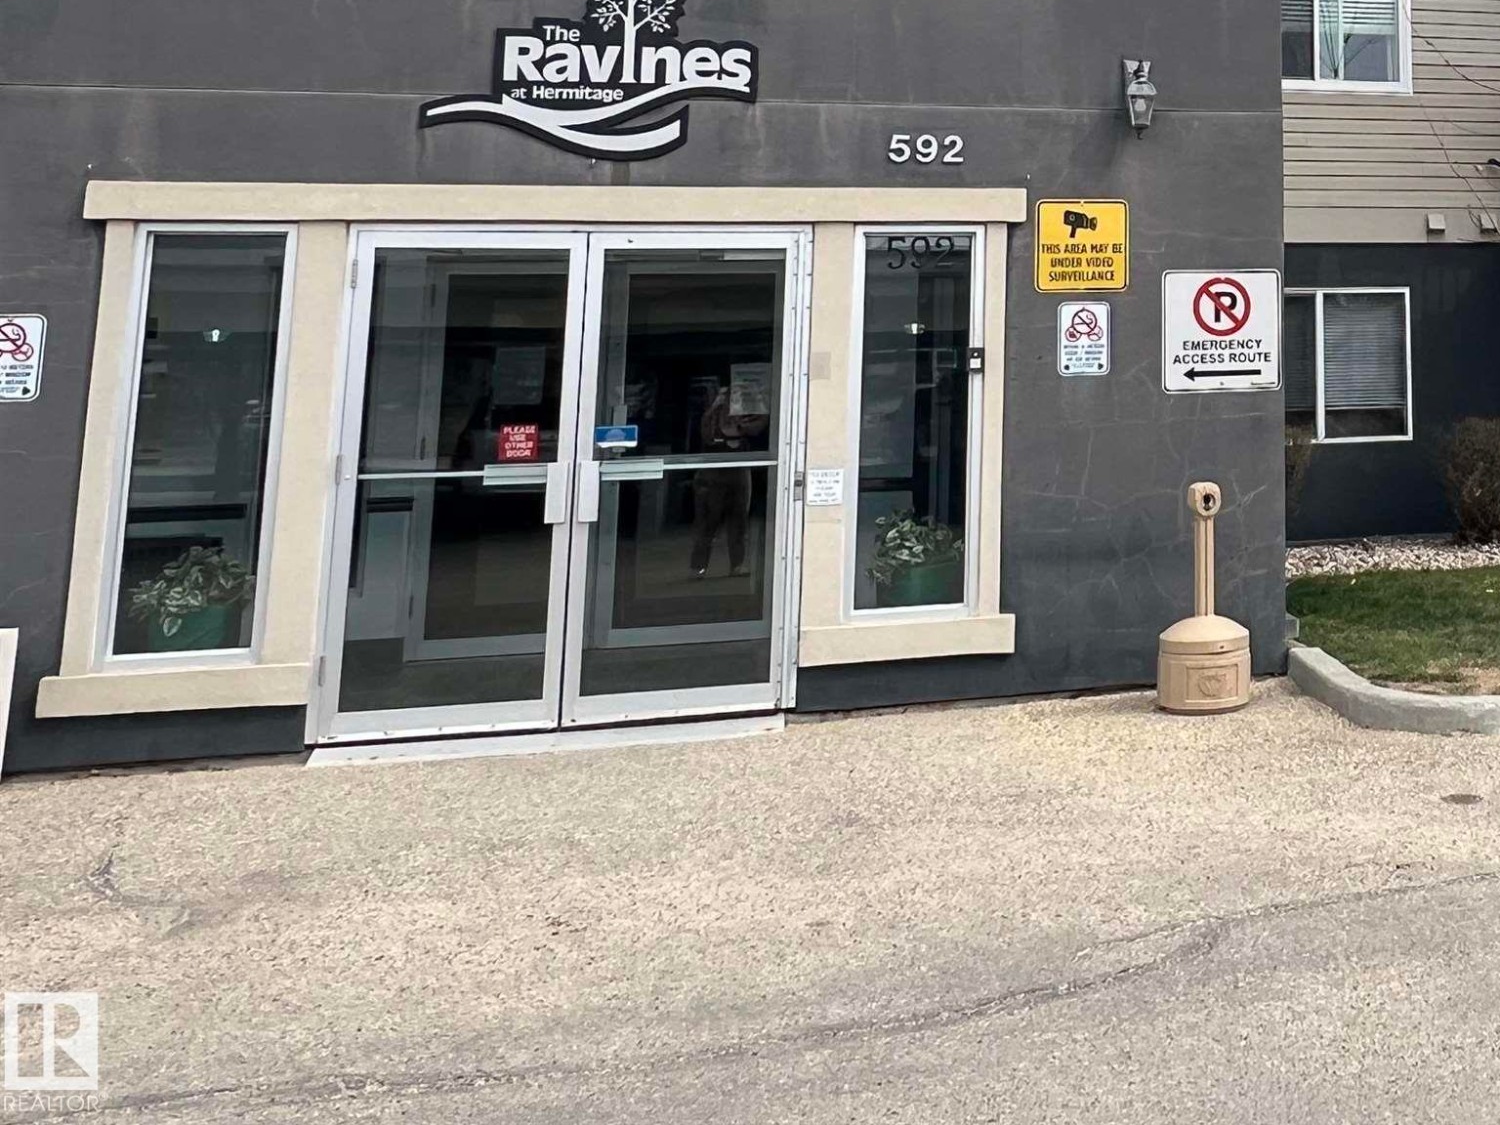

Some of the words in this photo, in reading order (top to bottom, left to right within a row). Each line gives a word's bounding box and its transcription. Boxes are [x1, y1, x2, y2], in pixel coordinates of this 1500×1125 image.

[543, 25, 581, 42] The
[511, 88, 527, 100] at
[532, 85, 625, 102] Hermitage
[888, 134, 964, 163] 592
[887, 236, 955, 269] 592
[1041, 243, 1061, 254] THIS
[1064, 243, 1087, 254] AREA
[1090, 243, 1109, 254] MAY
[1112, 243, 1123, 254] BE
[1050, 257, 1082, 268] UNDER
[1086, 257, 1114, 268] VIDEO
[1049, 270, 1115, 282] SURVEILLANCE
[1183, 339, 1262, 351] EMERGENCY
[1173, 353, 1225, 365] ACCESS
[1229, 352, 1272, 363] ROUTE
[503, 425, 535, 434] PLEASE
[505, 441, 533, 449] OTHER
[506, 449, 531, 457] DOOR
